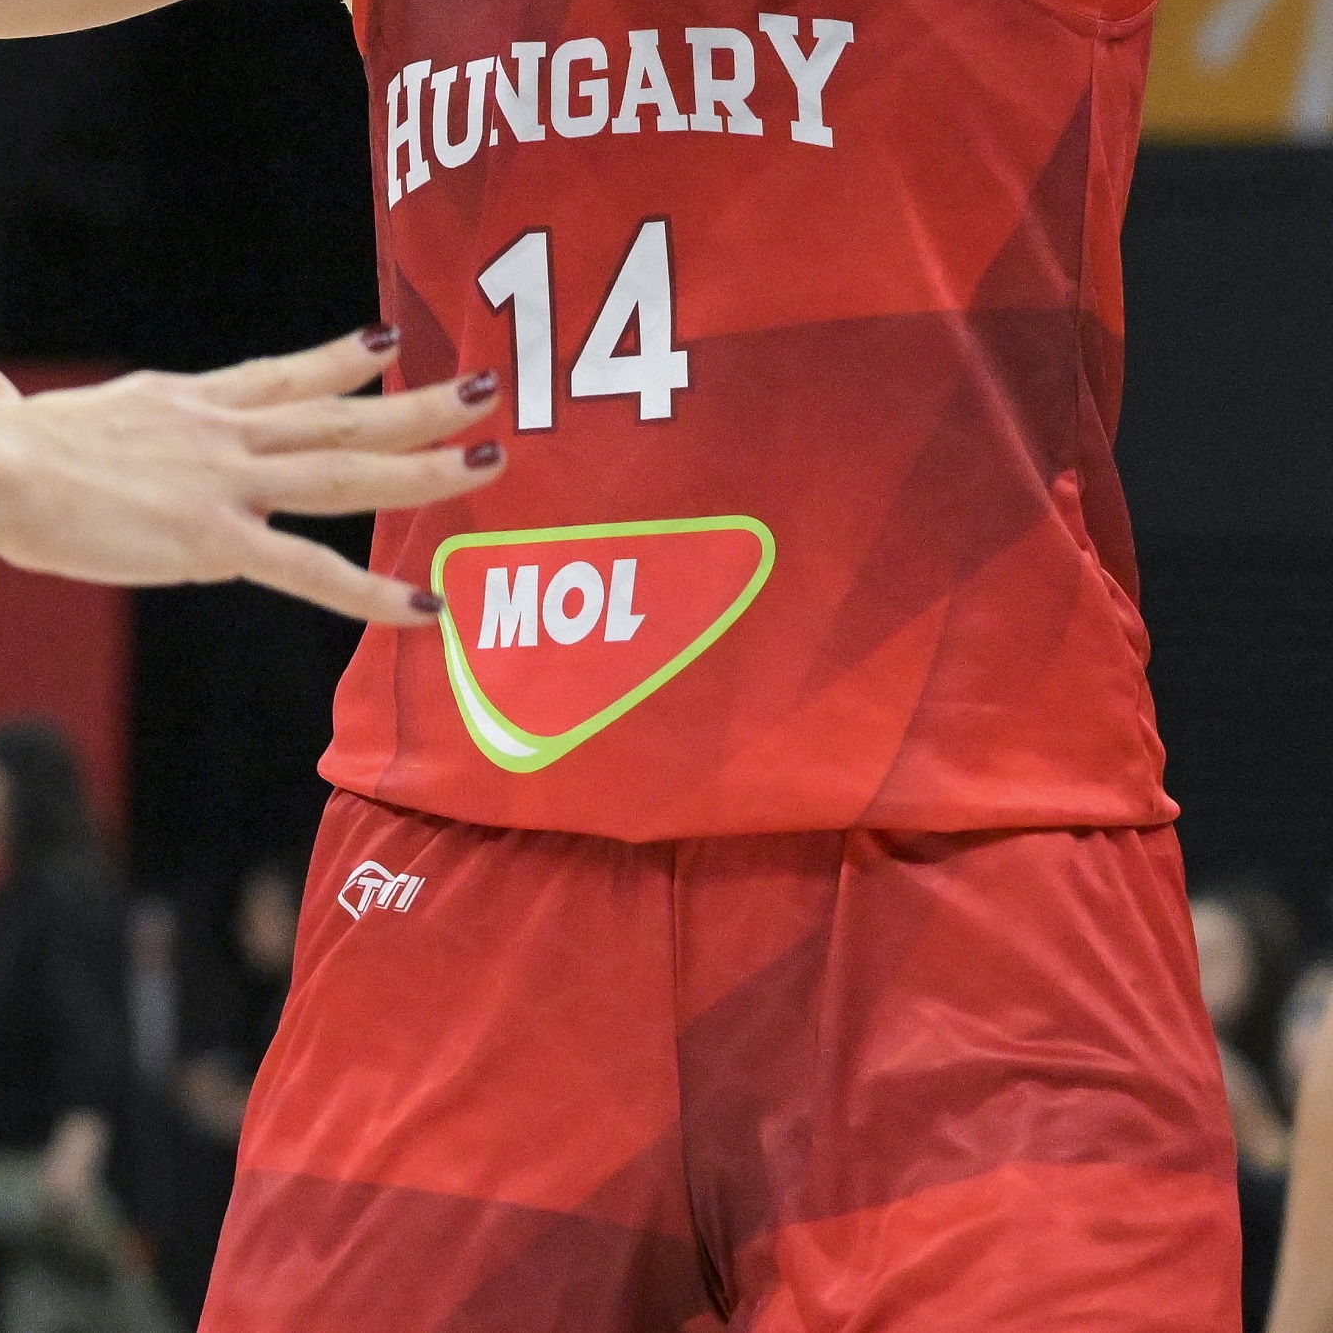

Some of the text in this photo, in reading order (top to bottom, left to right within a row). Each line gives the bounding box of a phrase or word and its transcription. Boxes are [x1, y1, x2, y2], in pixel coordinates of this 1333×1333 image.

[386, 12, 855, 211] HUNGARY
[476, 219, 690, 431] 14
[477, 558, 646, 650] MOL
